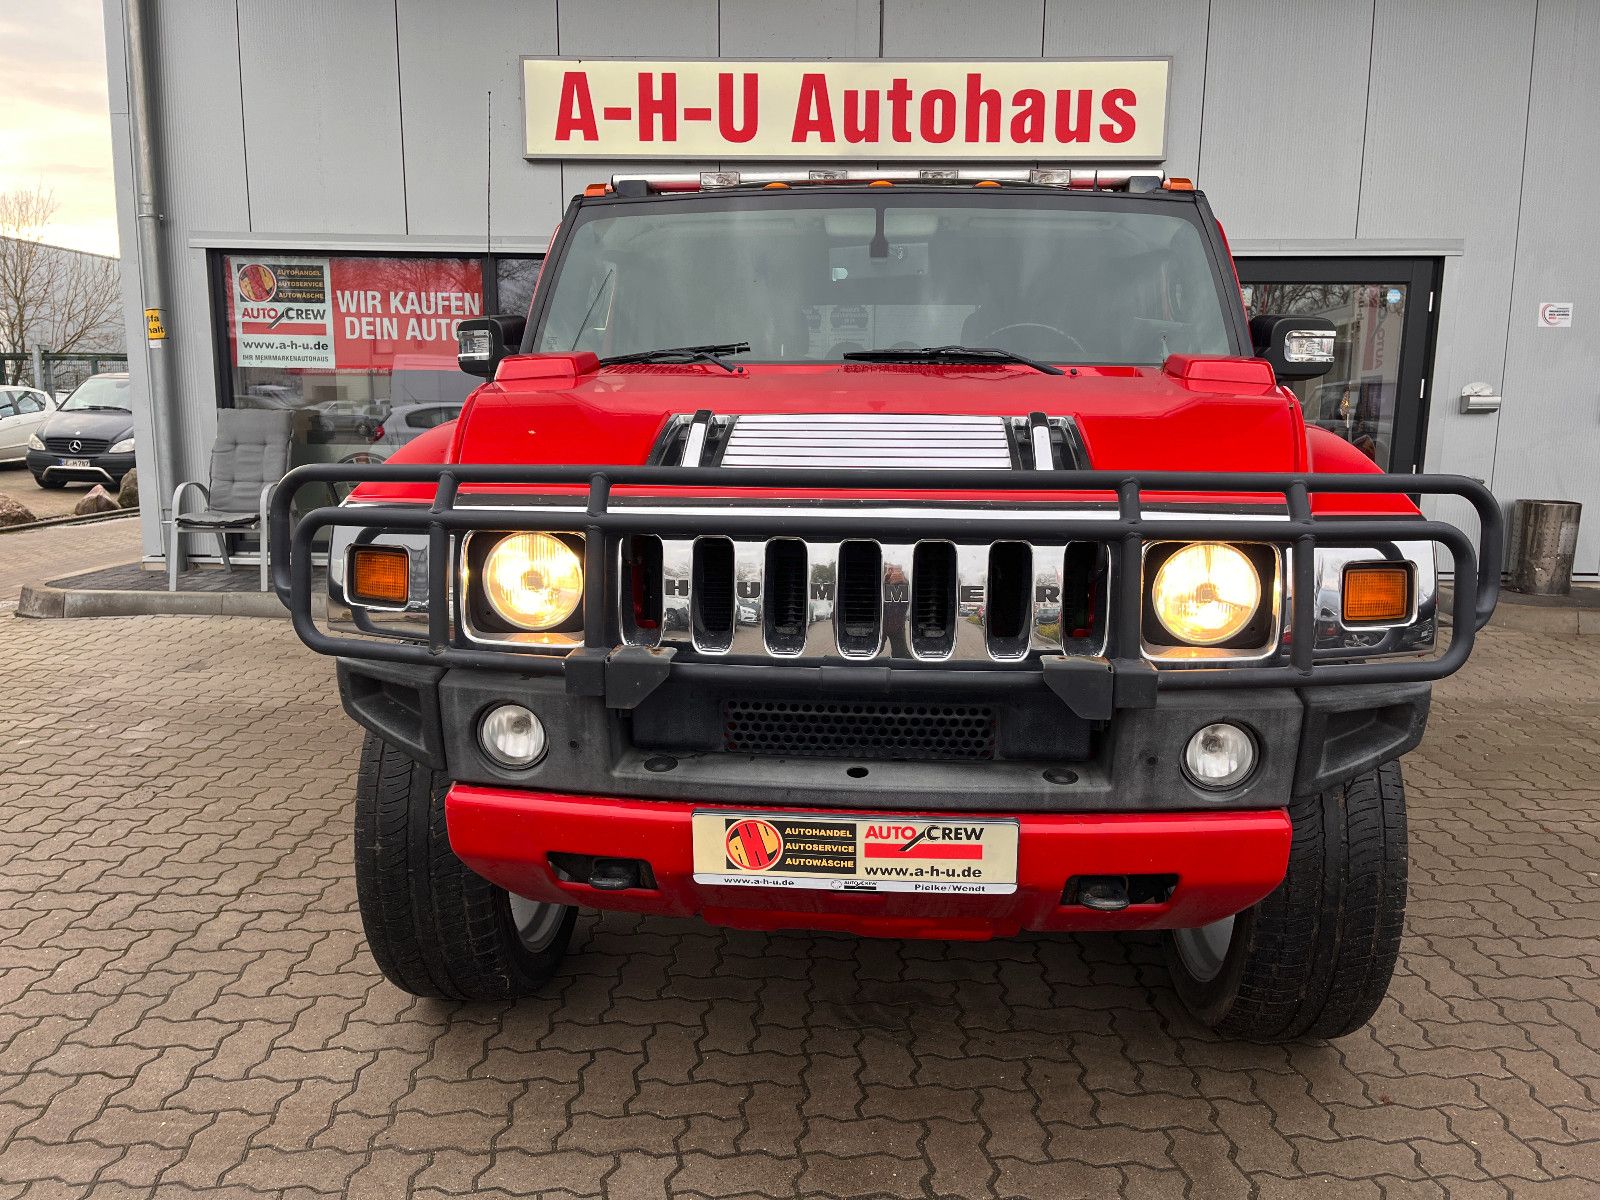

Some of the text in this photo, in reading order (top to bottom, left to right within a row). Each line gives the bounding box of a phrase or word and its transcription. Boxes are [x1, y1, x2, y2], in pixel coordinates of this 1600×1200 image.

[555, 71, 1136, 144] A-H-U Autohaus
[277, 280, 324, 288] AUTOSERVICE
[336, 290, 480, 315] WIR KAUFEN
[242, 307, 326, 320] AUTO CREW
[345, 317, 398, 340] DEIN
[243, 341, 329, 350] www.a-h-u.de
[785, 827, 852, 837] AUTOHANDEL
[865, 825, 985, 841] AUTO CREW
[785, 842, 855, 853] AUTOSERVICE
[785, 857, 855, 868] AUTOWÄSCHE
[865, 866, 982, 878] www.a-h-u.de
[723, 877, 795, 886] www.a-h-u.de
